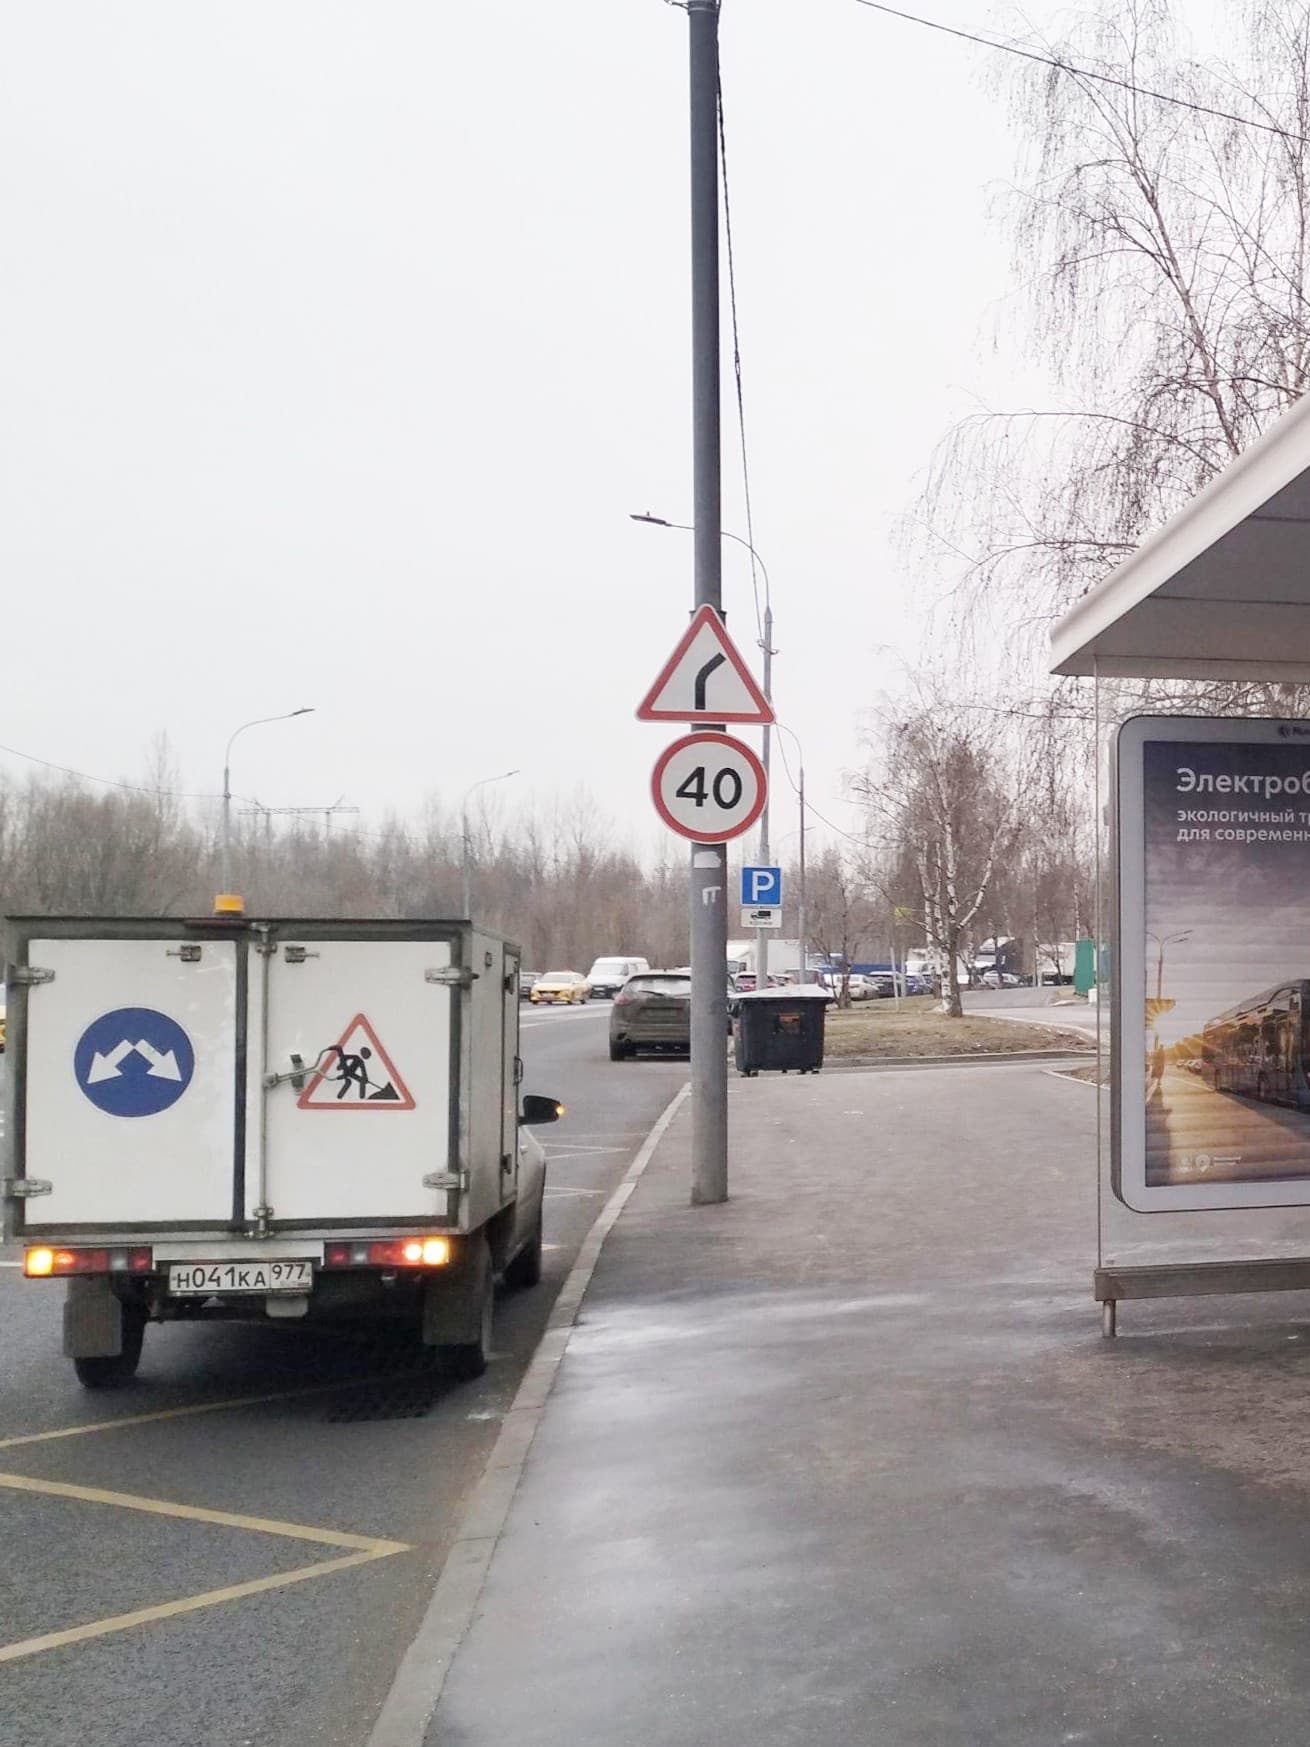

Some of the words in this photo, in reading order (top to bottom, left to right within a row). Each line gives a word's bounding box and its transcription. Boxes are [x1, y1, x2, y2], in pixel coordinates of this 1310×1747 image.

[675, 766, 743, 810] 40
[1177, 808, 1295, 823] экологичный
[1177, 828, 1211, 842] для
[752, 870, 776, 901] P
[271, 1263, 306, 1280] 977
